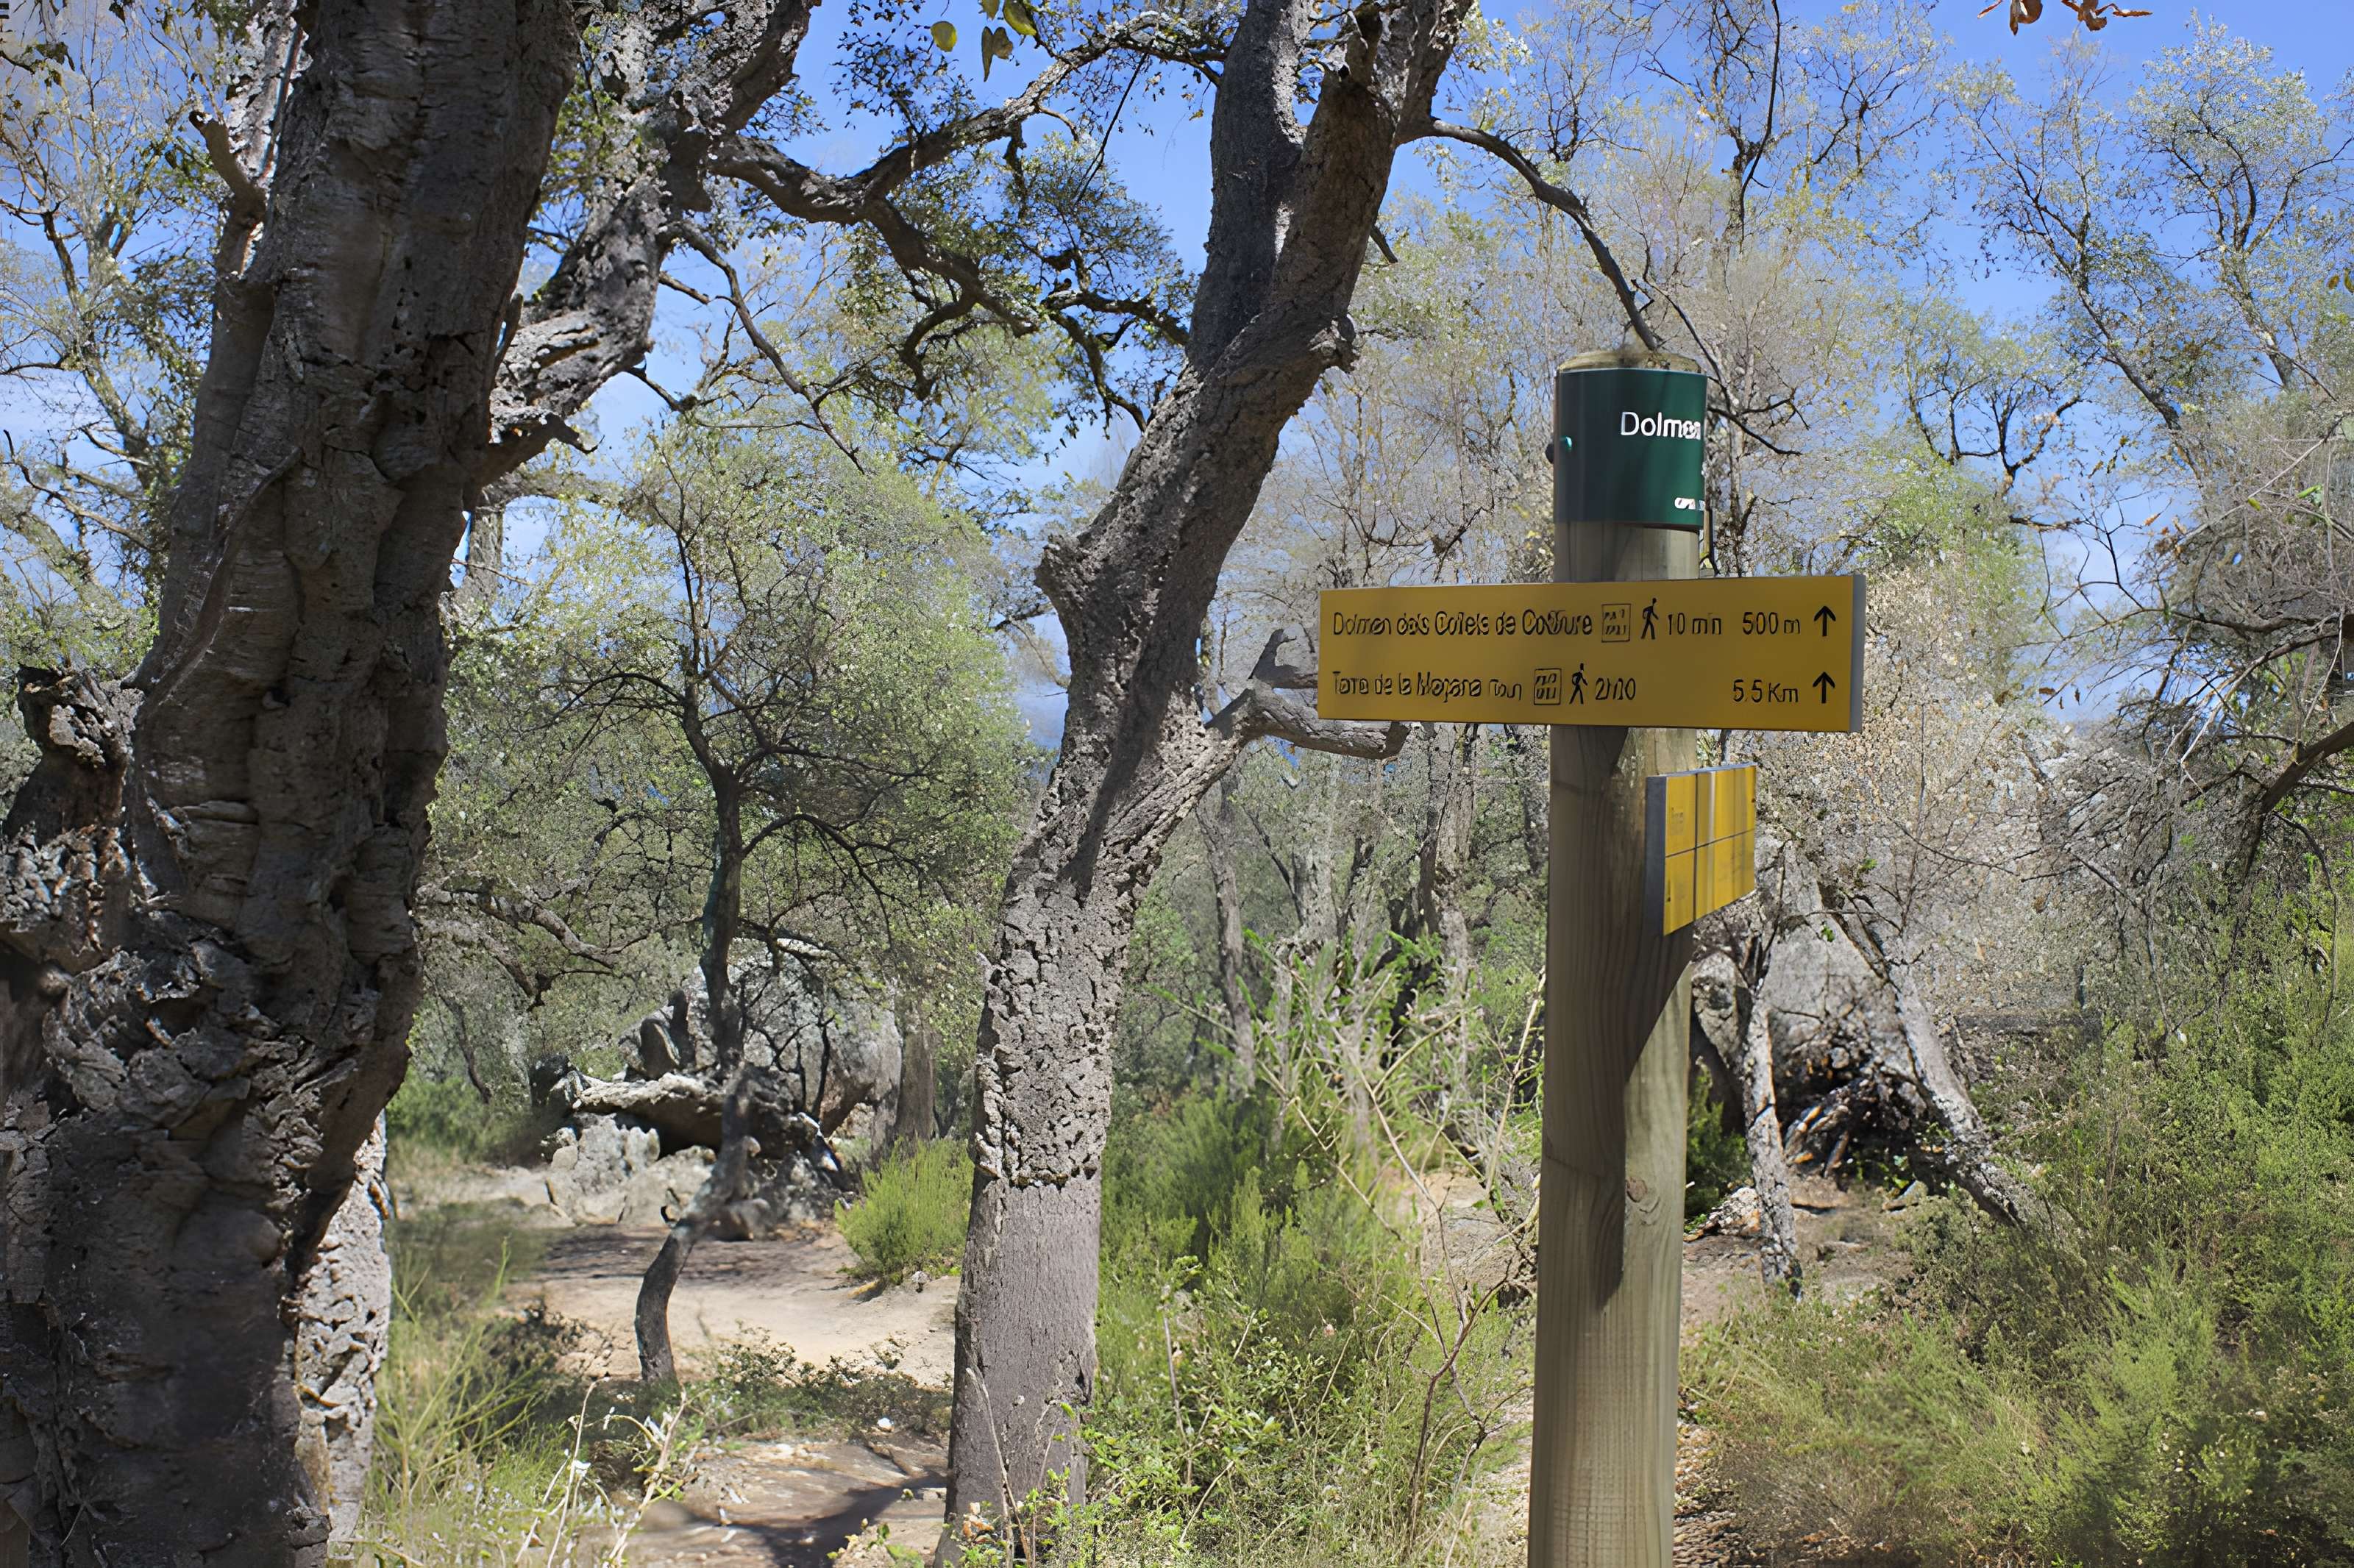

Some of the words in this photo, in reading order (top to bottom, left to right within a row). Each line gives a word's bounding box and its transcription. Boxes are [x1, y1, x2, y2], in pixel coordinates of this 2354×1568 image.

[1620, 410, 1702, 441] Dolmen
[1495, 611, 1517, 636] de
[1667, 612, 1686, 635] 10
